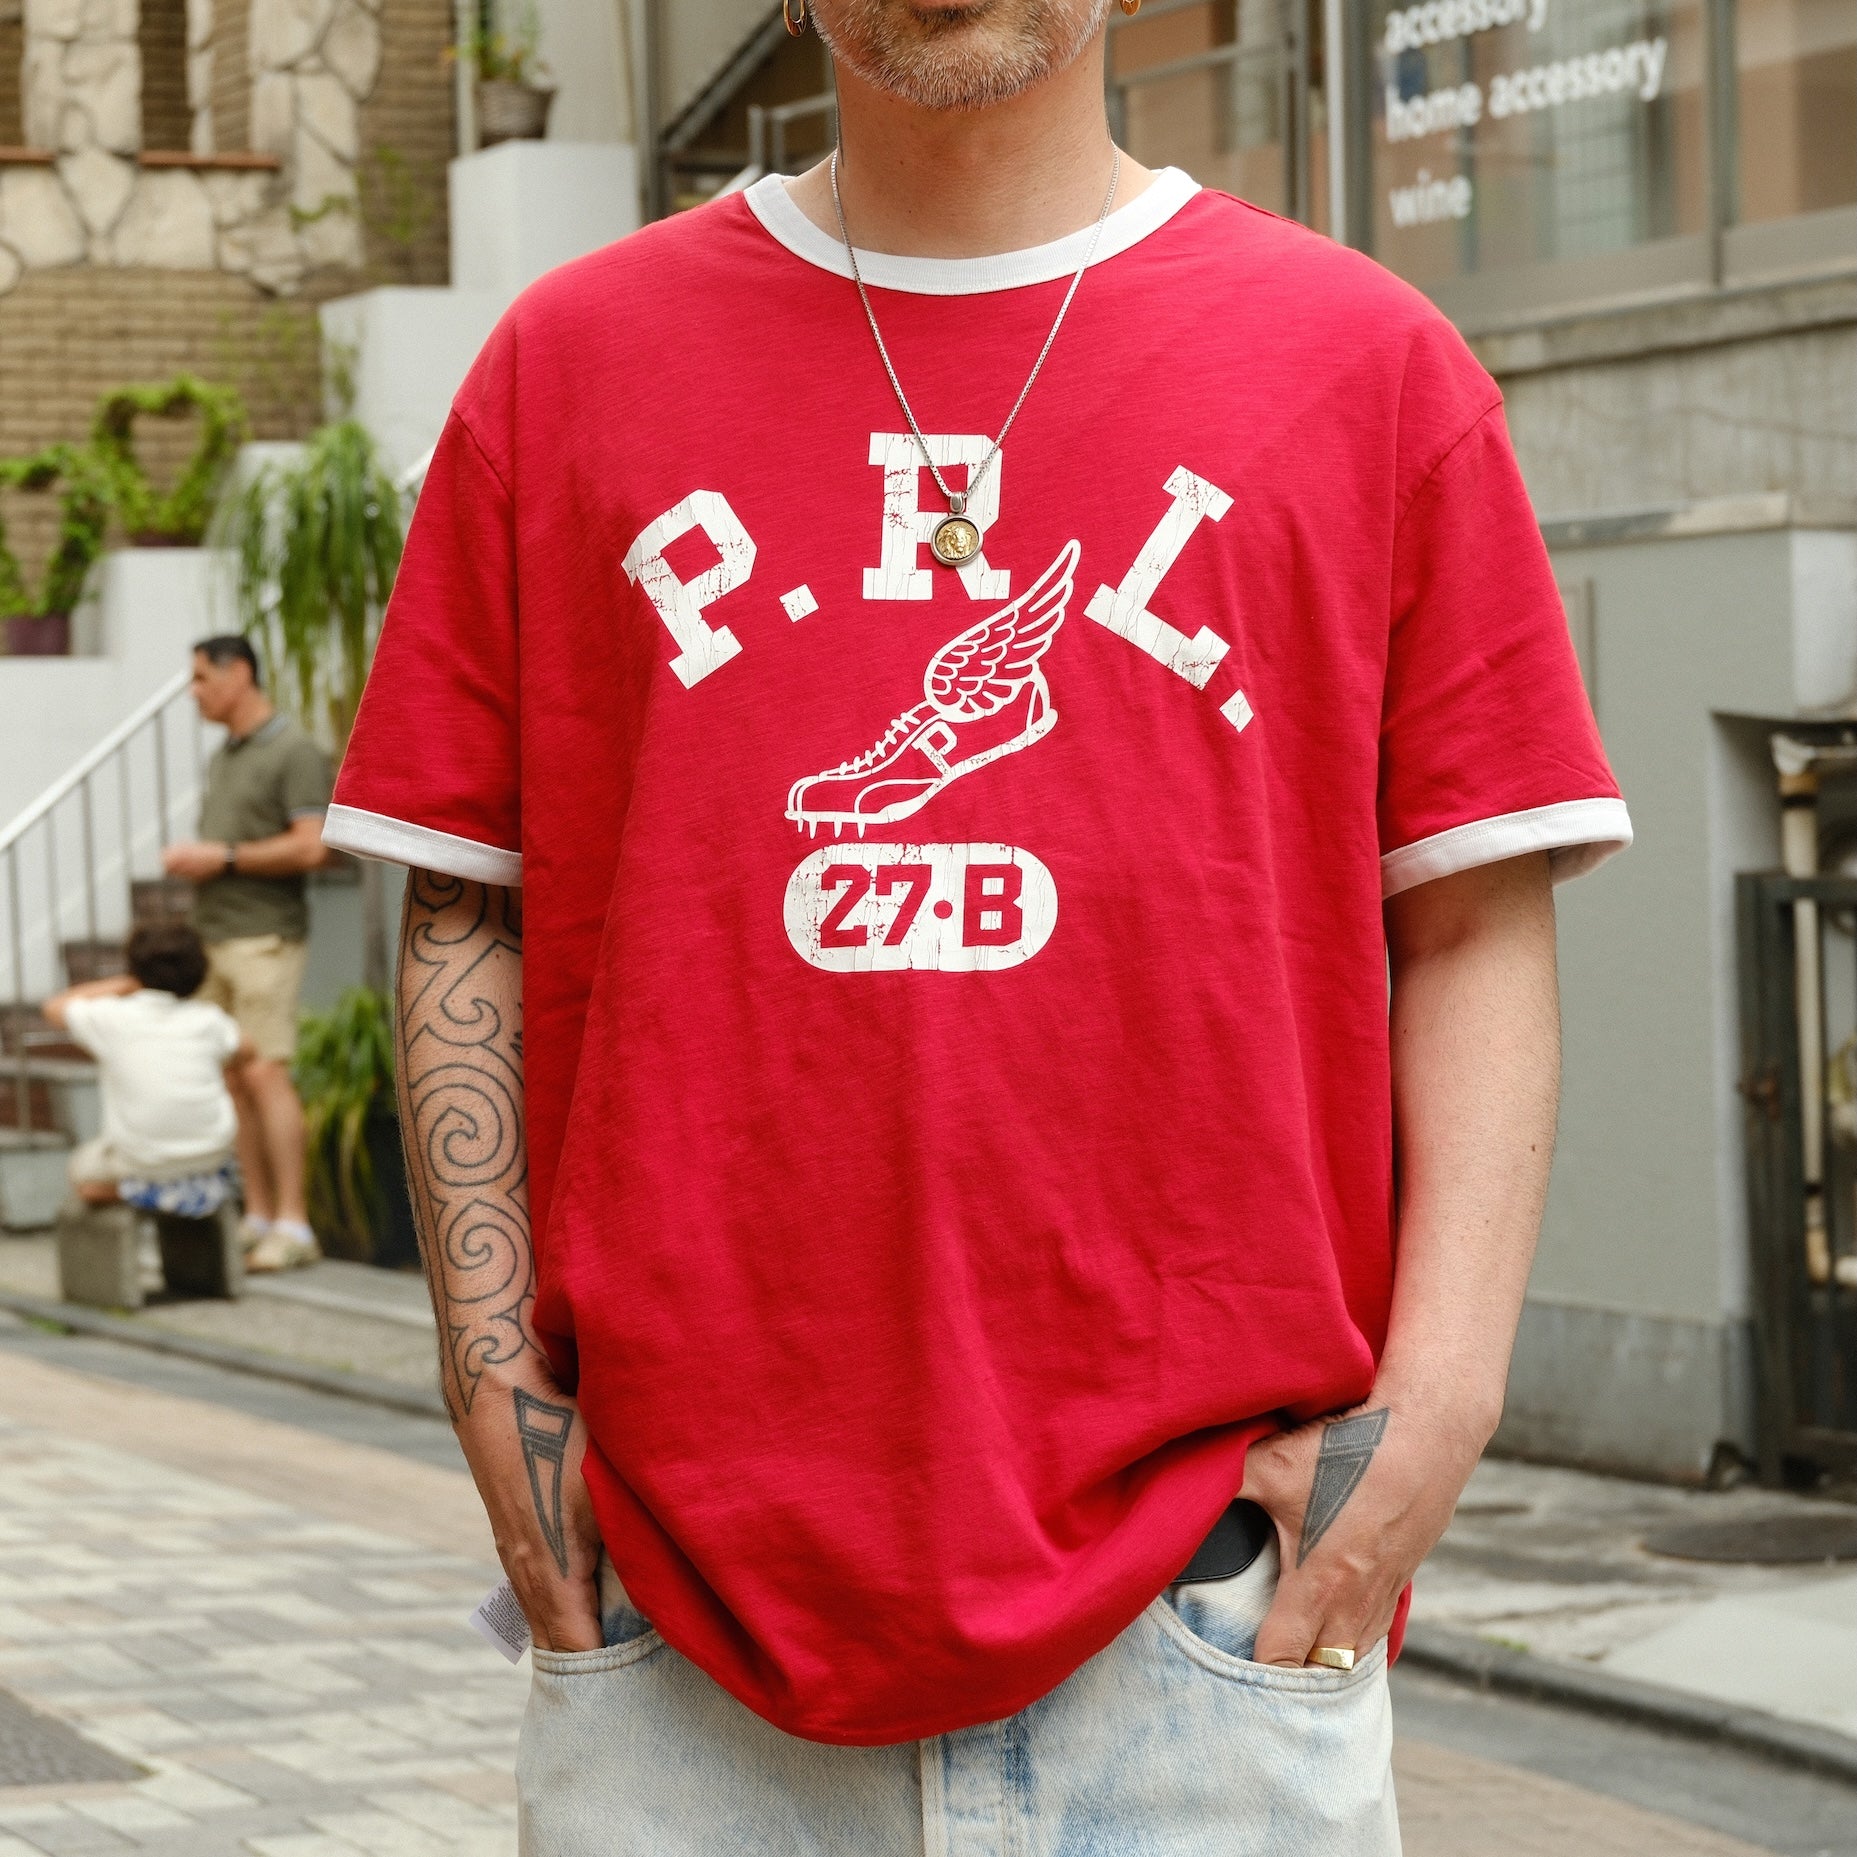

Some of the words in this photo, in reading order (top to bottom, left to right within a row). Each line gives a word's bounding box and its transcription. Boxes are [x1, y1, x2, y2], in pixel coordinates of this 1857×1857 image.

[1385, 82, 1483, 142] home
[1488, 35, 1668, 119] accessory
[1389, 168, 1472, 228] wine
